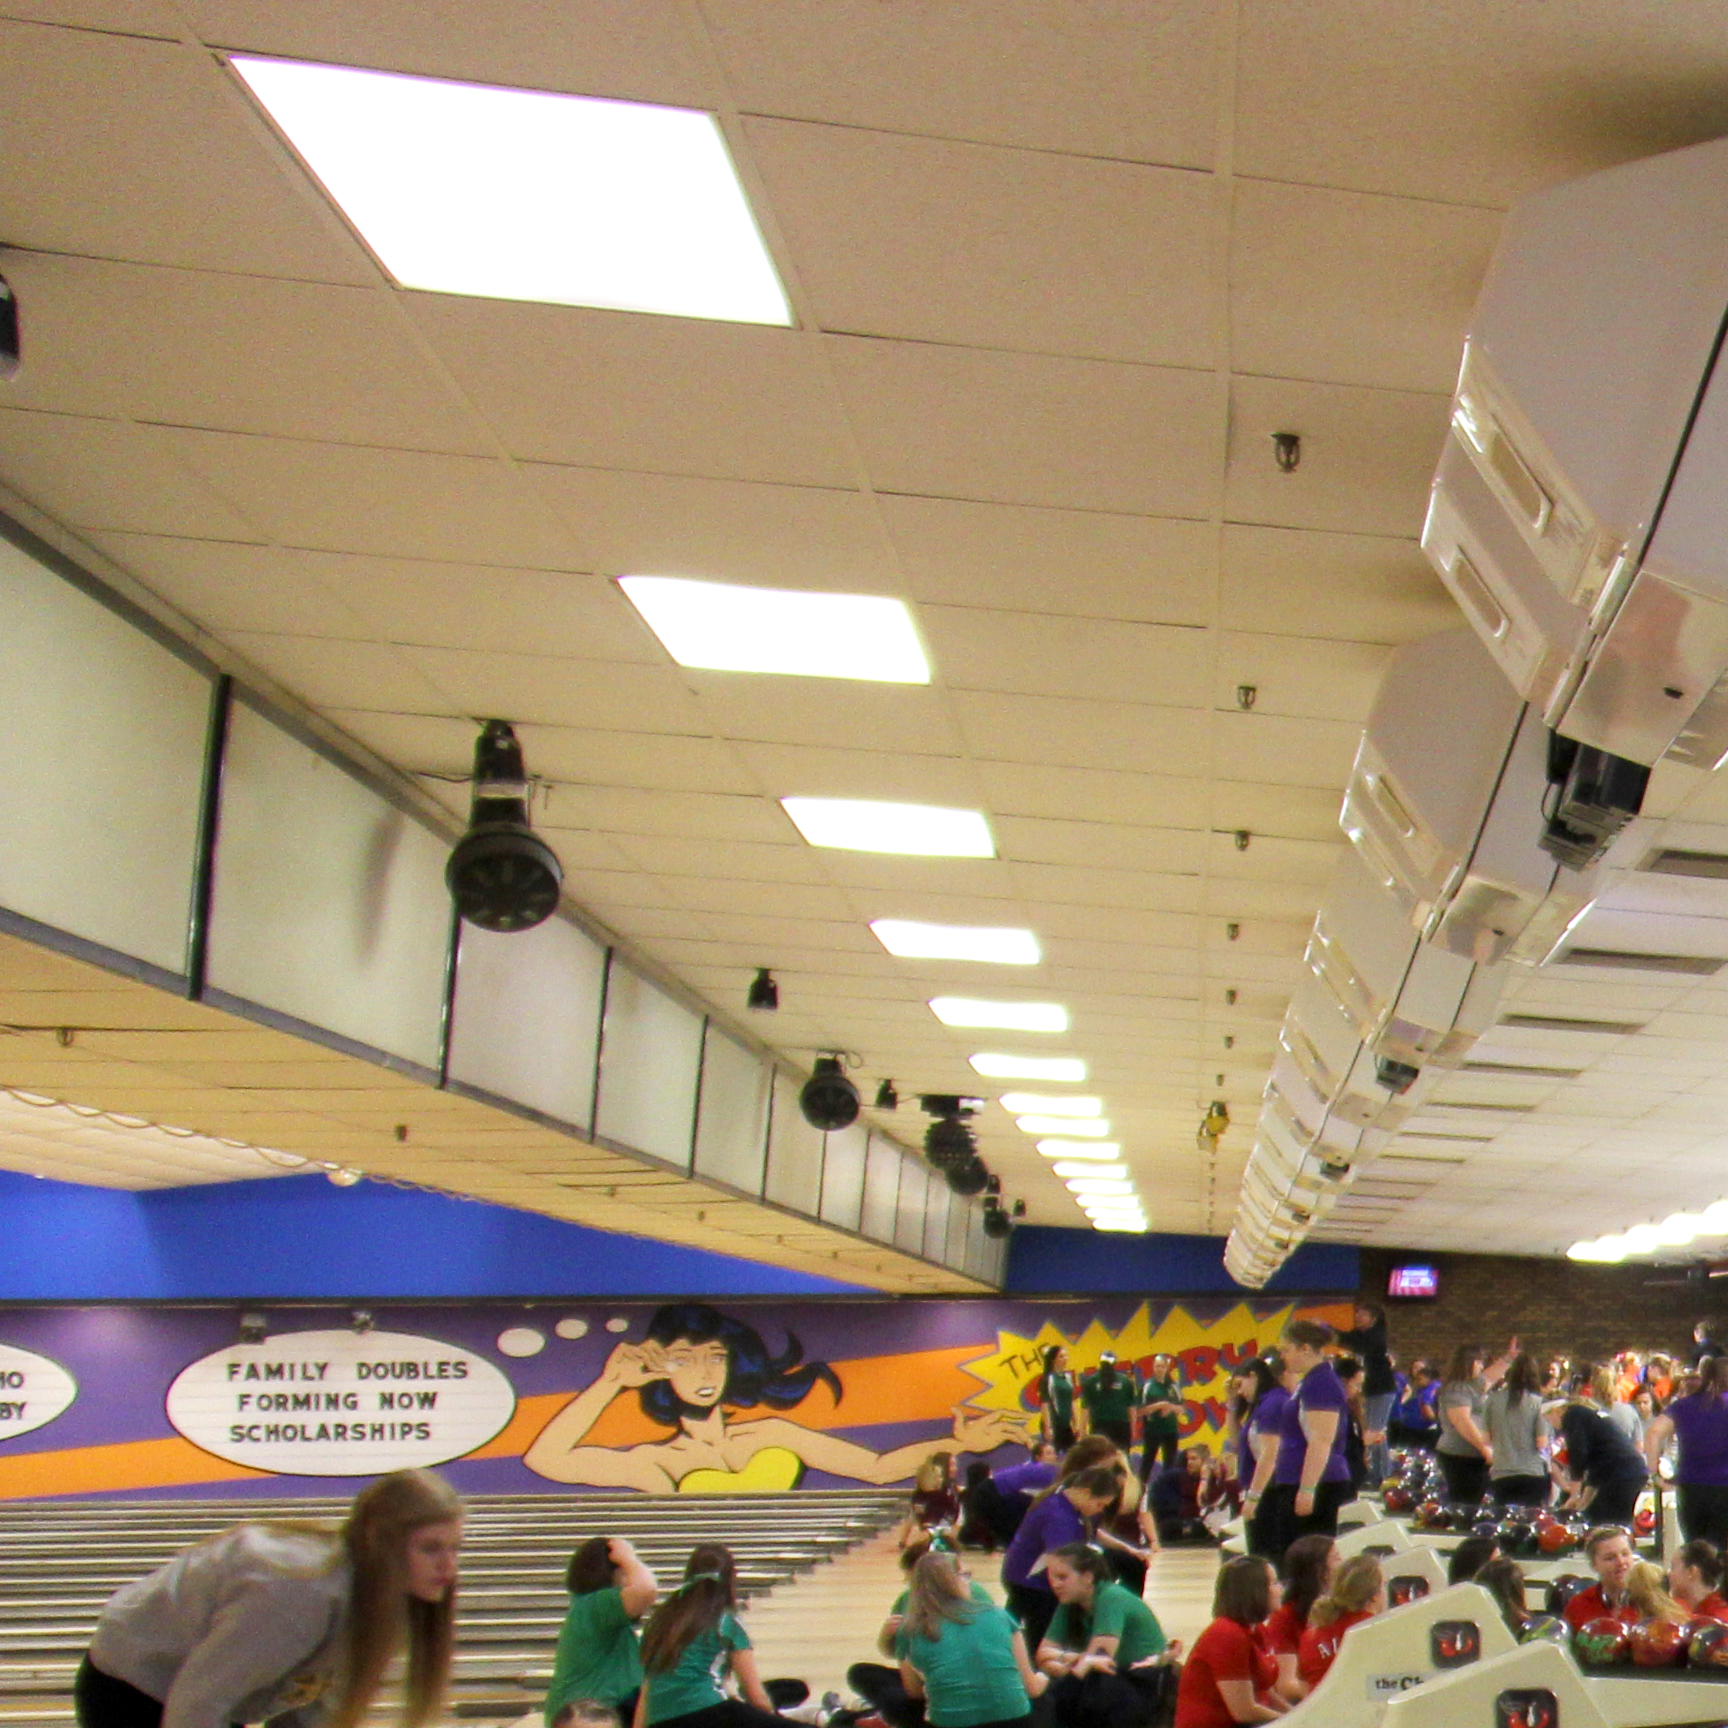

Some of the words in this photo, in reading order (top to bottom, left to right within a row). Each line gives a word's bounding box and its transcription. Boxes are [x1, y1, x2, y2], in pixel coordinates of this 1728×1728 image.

[227, 1361, 329, 1381] FAMILY
[356, 1361, 468, 1380] DOUBLES
[237, 1392, 359, 1412] FORMING
[378, 1391, 438, 1410] NOW
[229, 1421, 431, 1442] SCHOLARSHIPS
[1375, 1677, 1398, 1689] the
